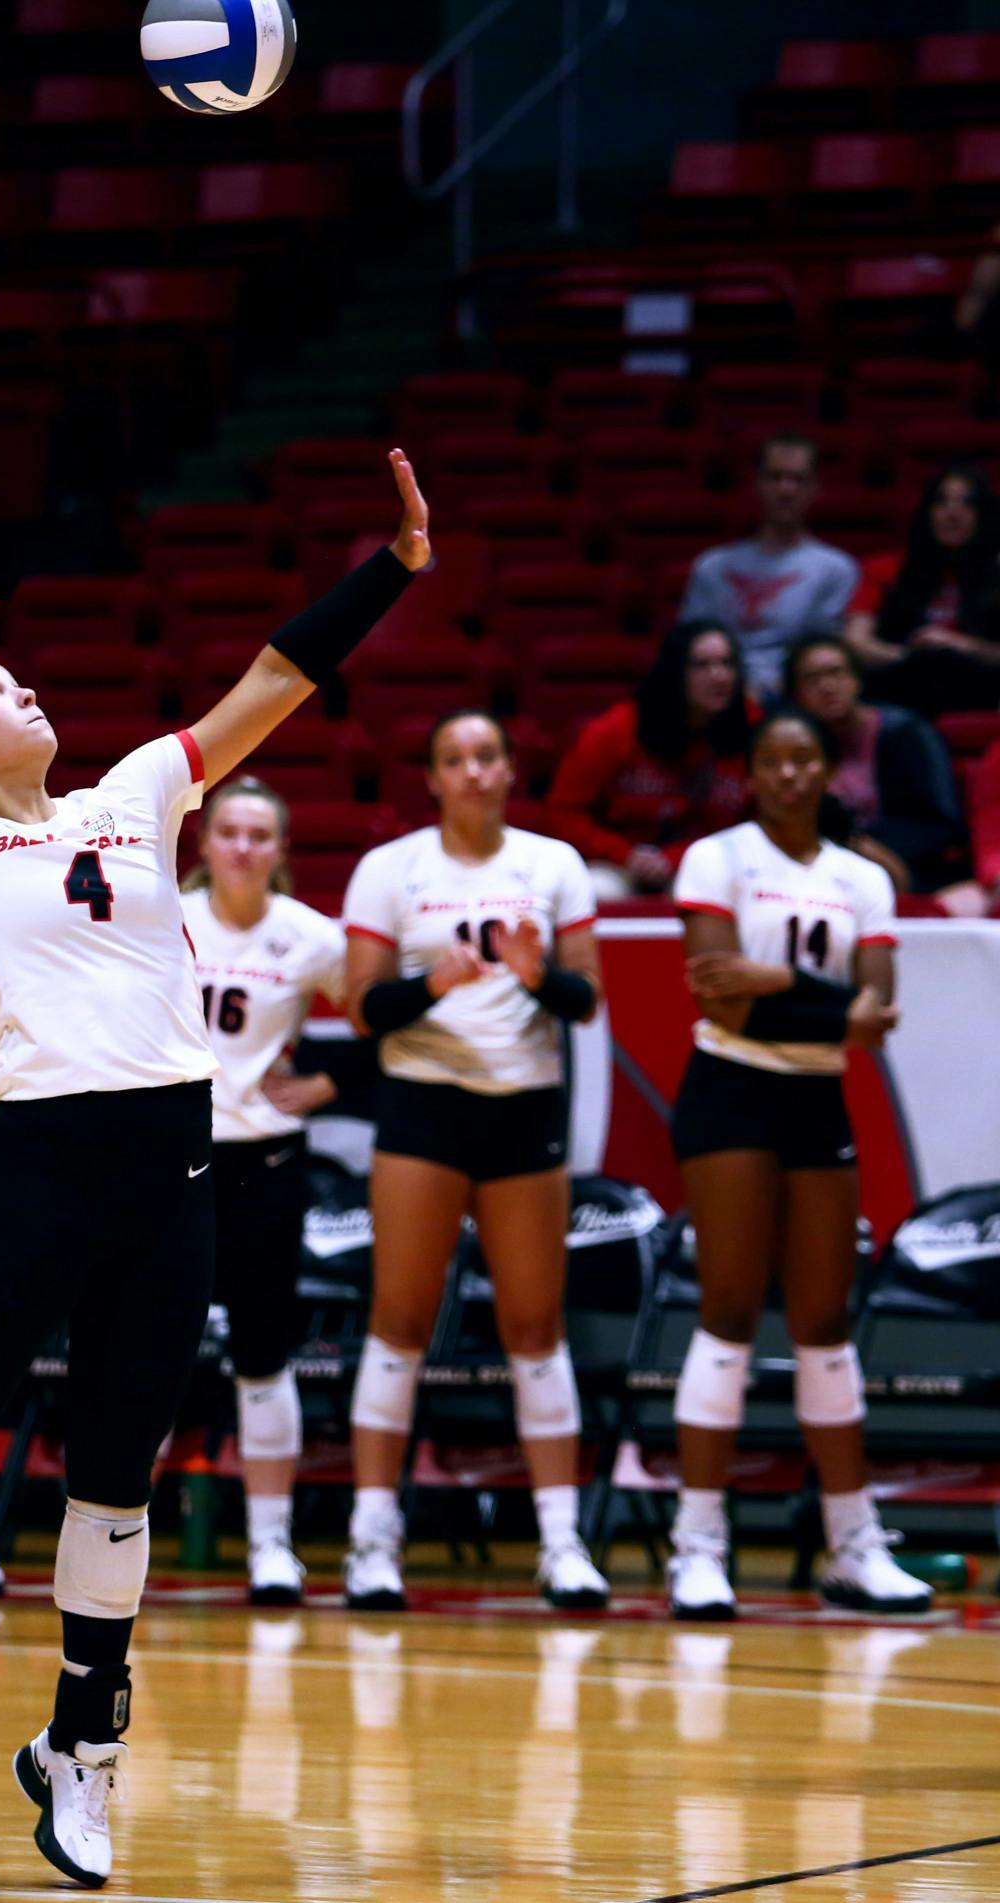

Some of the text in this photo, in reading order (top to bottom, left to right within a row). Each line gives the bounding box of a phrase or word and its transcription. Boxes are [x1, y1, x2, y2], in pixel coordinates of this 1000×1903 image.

[63, 850, 114, 921] 4
[787, 915, 829, 968] 14
[201, 985, 248, 1034] 16
